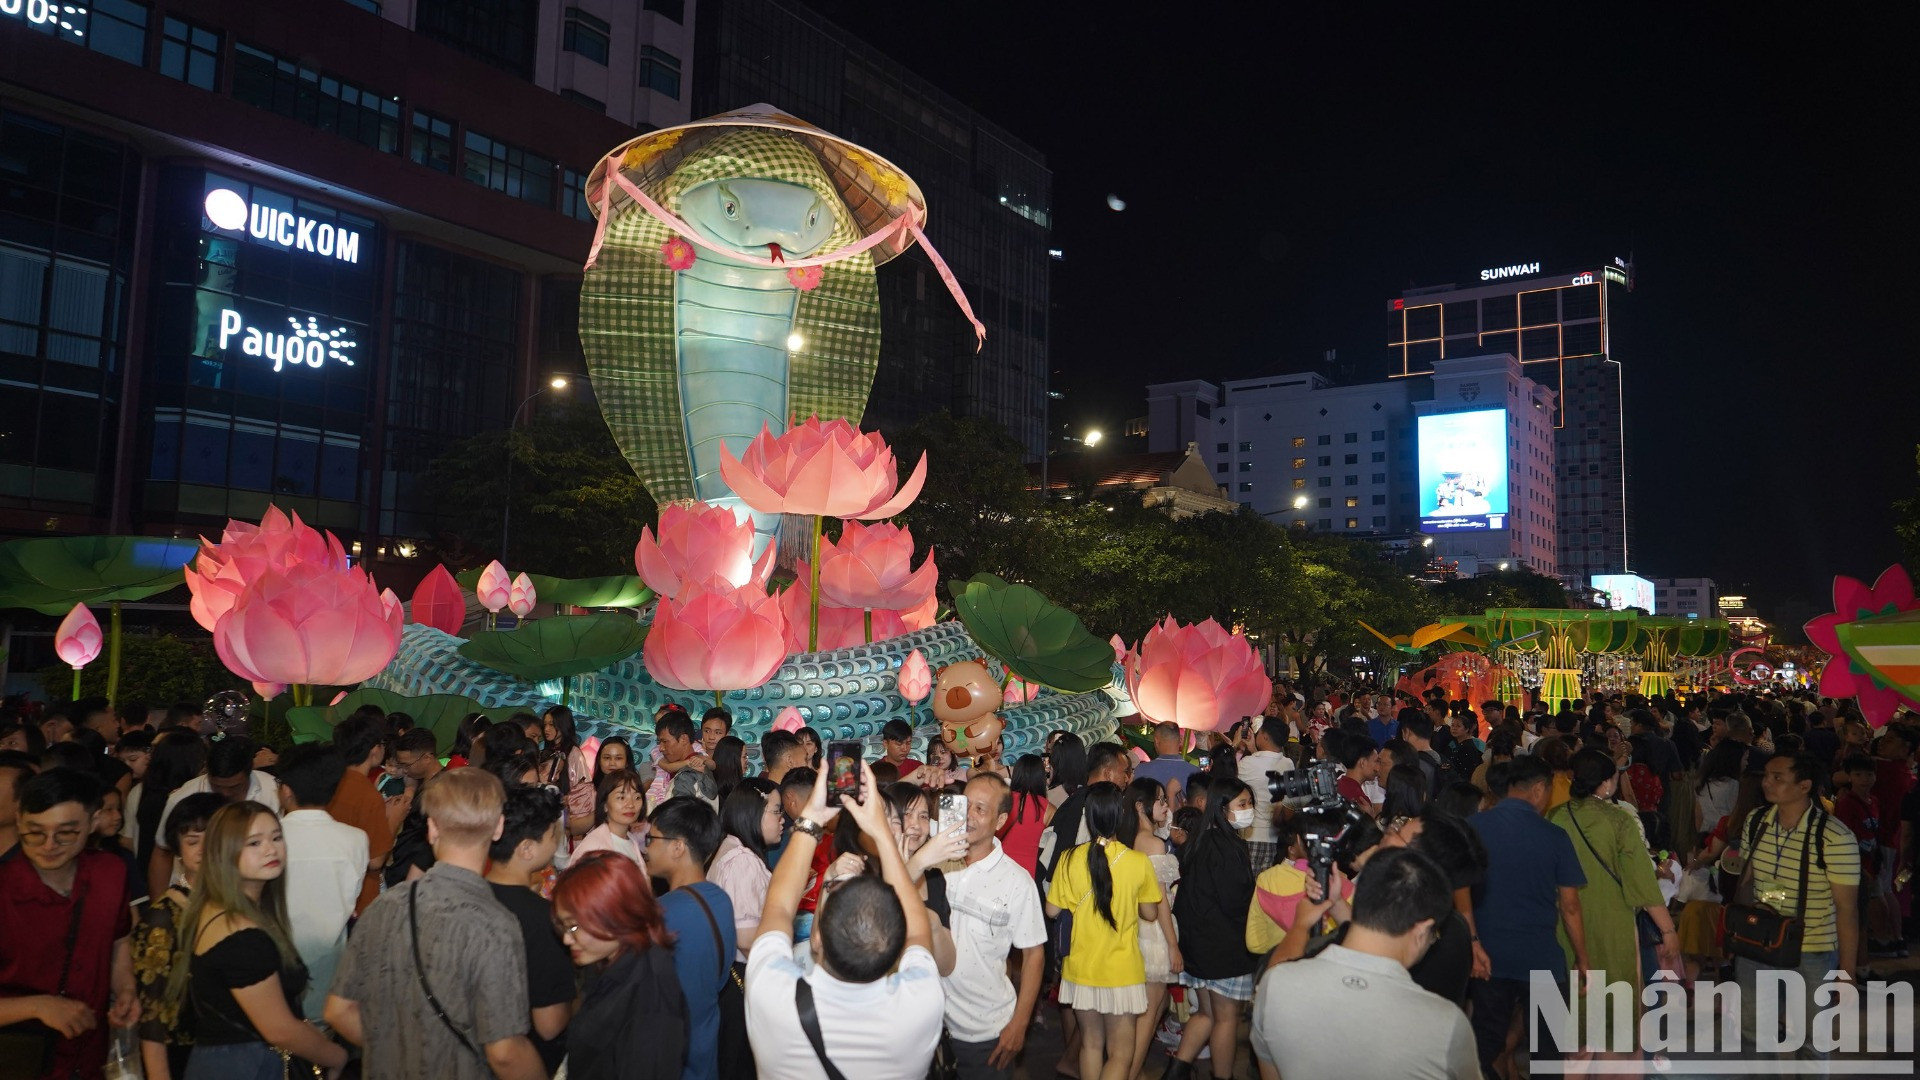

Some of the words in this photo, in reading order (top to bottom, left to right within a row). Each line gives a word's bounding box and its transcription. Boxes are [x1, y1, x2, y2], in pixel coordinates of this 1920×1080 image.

[1480, 262, 1540, 281] SUNWAH
[1572, 272, 1593, 286] citi
[219, 308, 324, 372] Payoo
